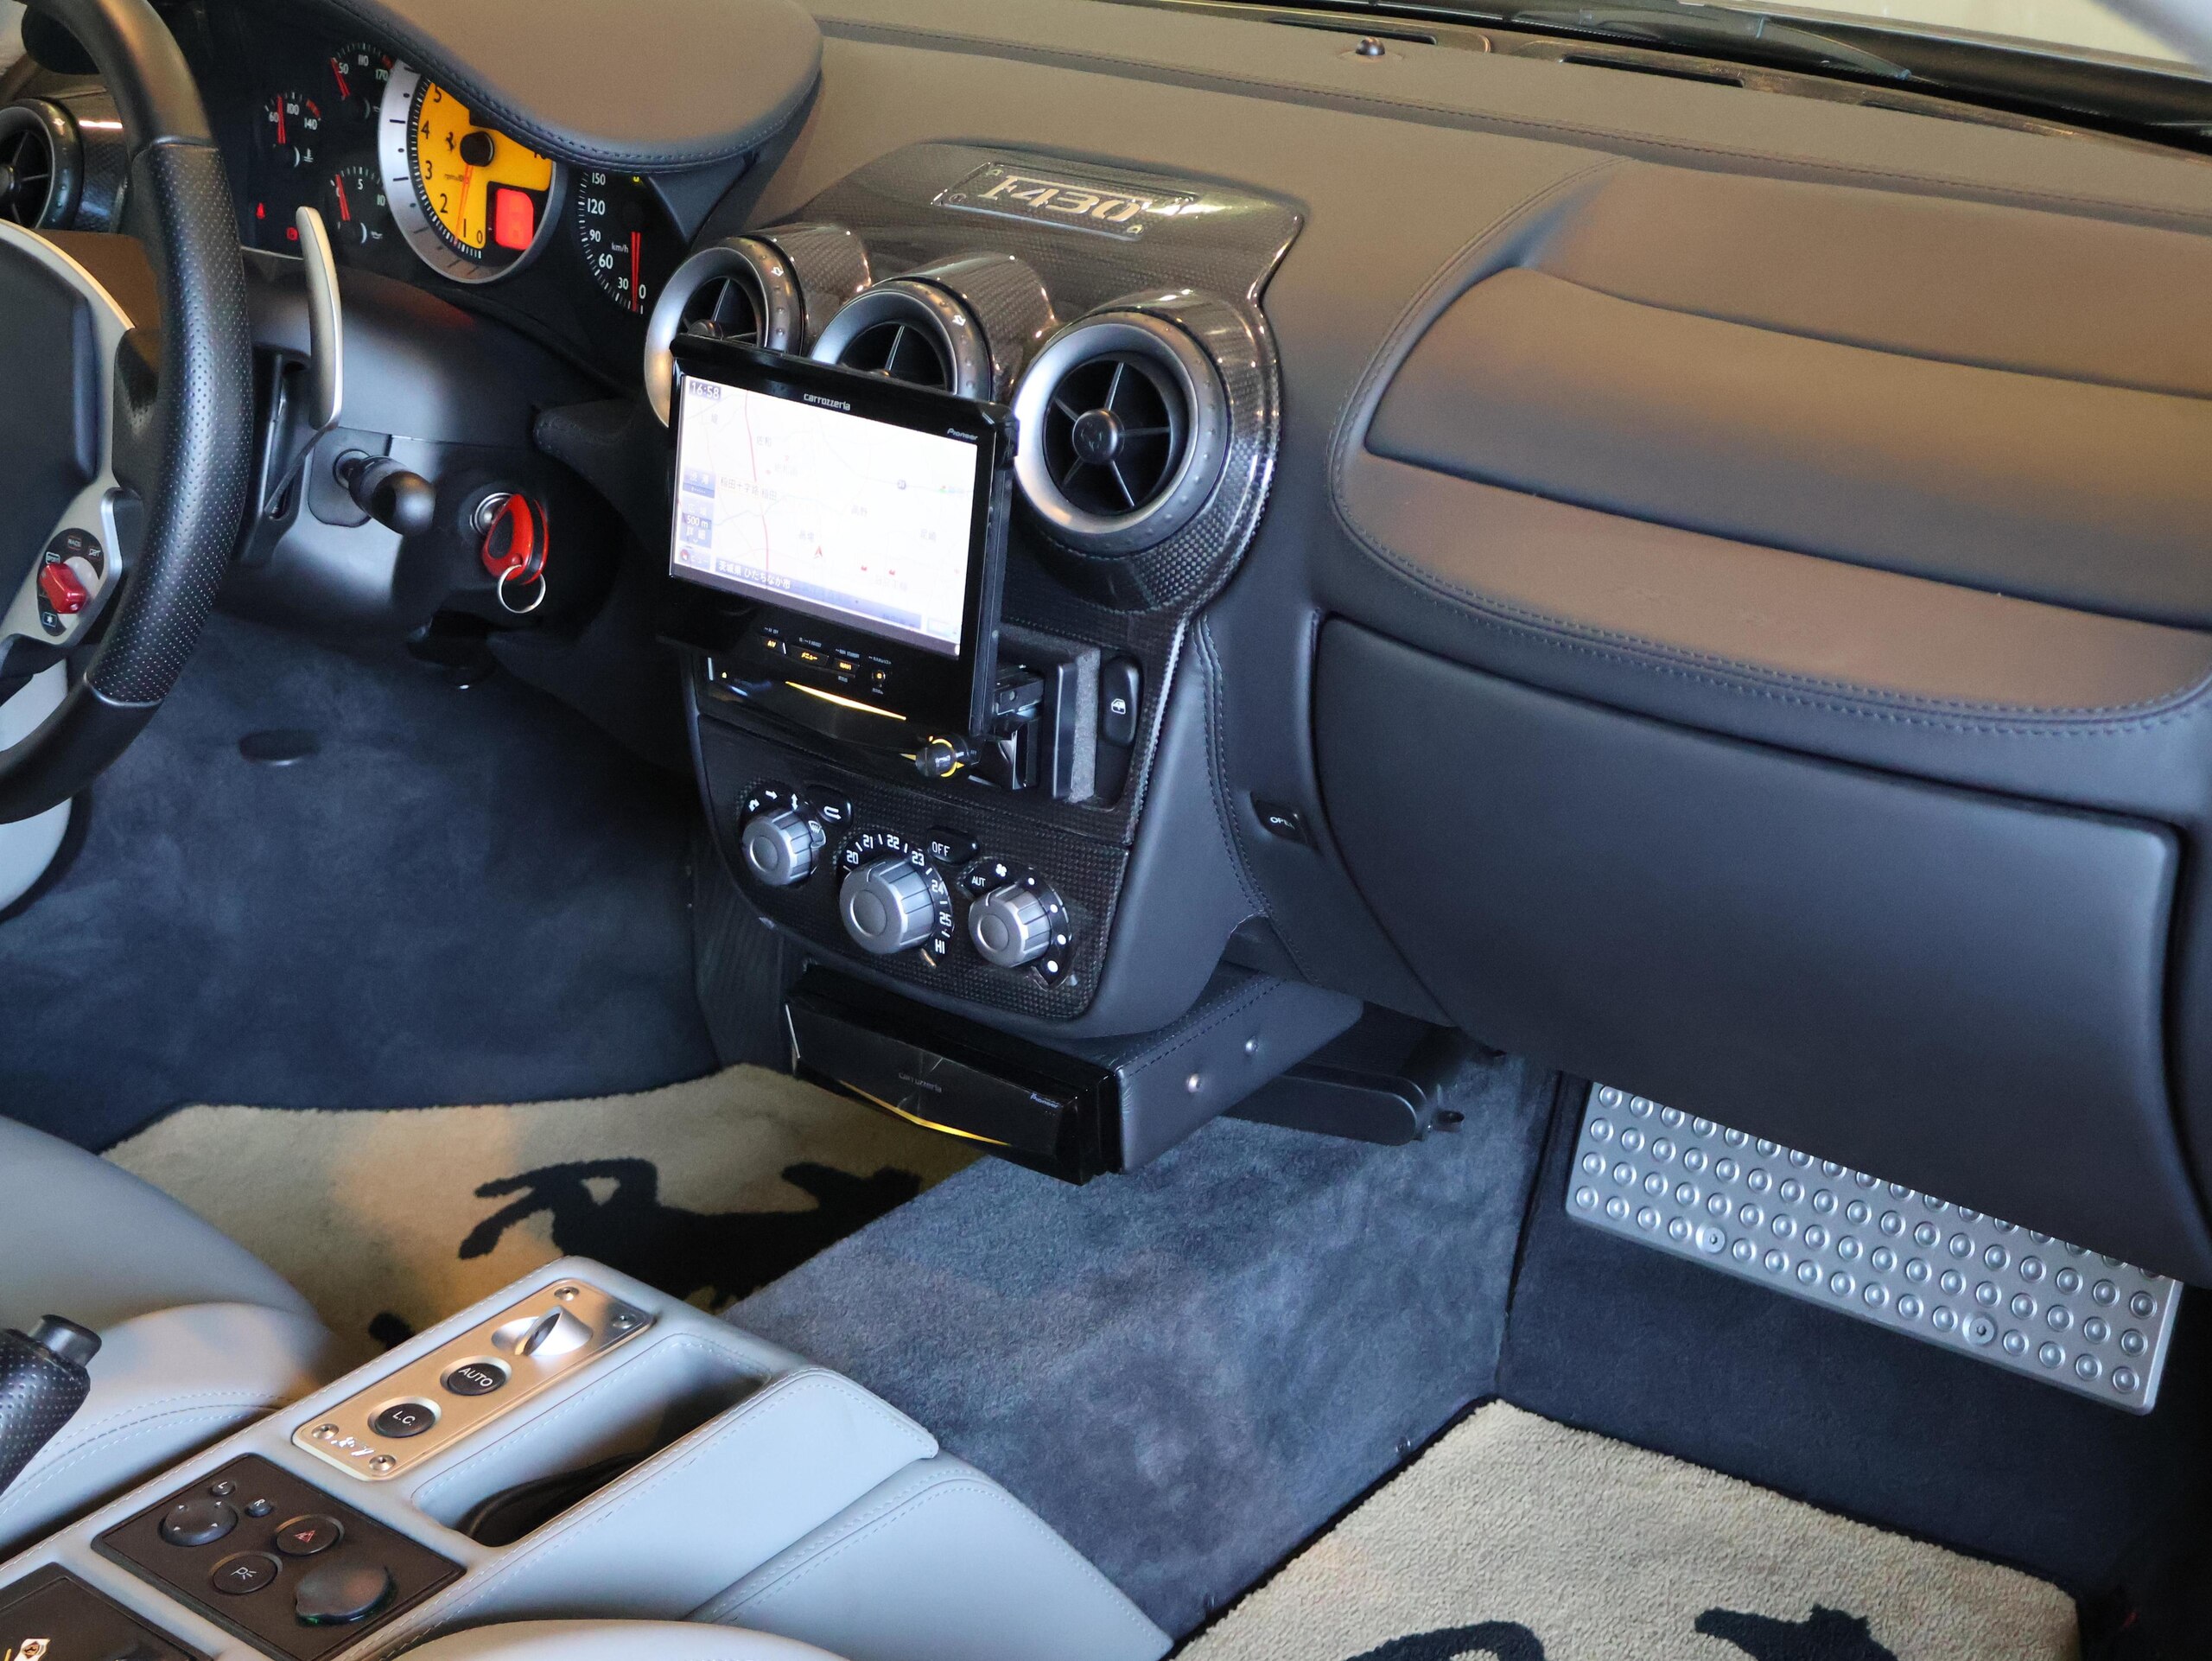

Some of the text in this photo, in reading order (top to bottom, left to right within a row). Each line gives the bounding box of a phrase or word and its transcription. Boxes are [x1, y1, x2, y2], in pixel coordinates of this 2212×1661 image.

[338, 62, 349, 75] 50
[375, 69, 388, 81] 170
[269, 111, 279, 123] 60
[286, 104, 300, 116] 100
[304, 118, 318, 130] 140
[421, 120, 430, 139] 4
[425, 160, 433, 180] 3
[357, 178, 364, 190] 5
[592, 173, 606, 186] 150
[377, 194, 386, 207] 10
[440, 194, 448, 213] 2
[587, 198, 606, 215] 120
[476, 230, 483, 244] 0
[589, 229, 601, 242] 90
[611, 242, 629, 253] km/h
[598, 253, 613, 270] 60
[617, 277, 629, 290] 30
[639, 284, 646, 299] 0
[690, 382, 721, 399] 16:58
[804, 392, 851, 410] carrozzeria
[947, 428, 978, 441] Pioneer
[687, 515, 709, 529] 500 m
[744, 568, 791, 589] ひたちなか市
[766, 640, 777, 648] AV
[862, 834, 874, 850] 21
[887, 833, 900, 850] 22
[931, 841, 950, 857] OFF
[846, 850, 859, 865] 20
[912, 850, 925, 867] 23
[931, 879, 945, 895] 24
[971, 875, 986, 888] AUT
[939, 912, 951, 927] 25
[935, 939, 945, 954] HI
[458, 1367, 493, 1388] AUTO
[391, 1410, 416, 1426] L.C.
[253, 1499, 266, 1507] R
